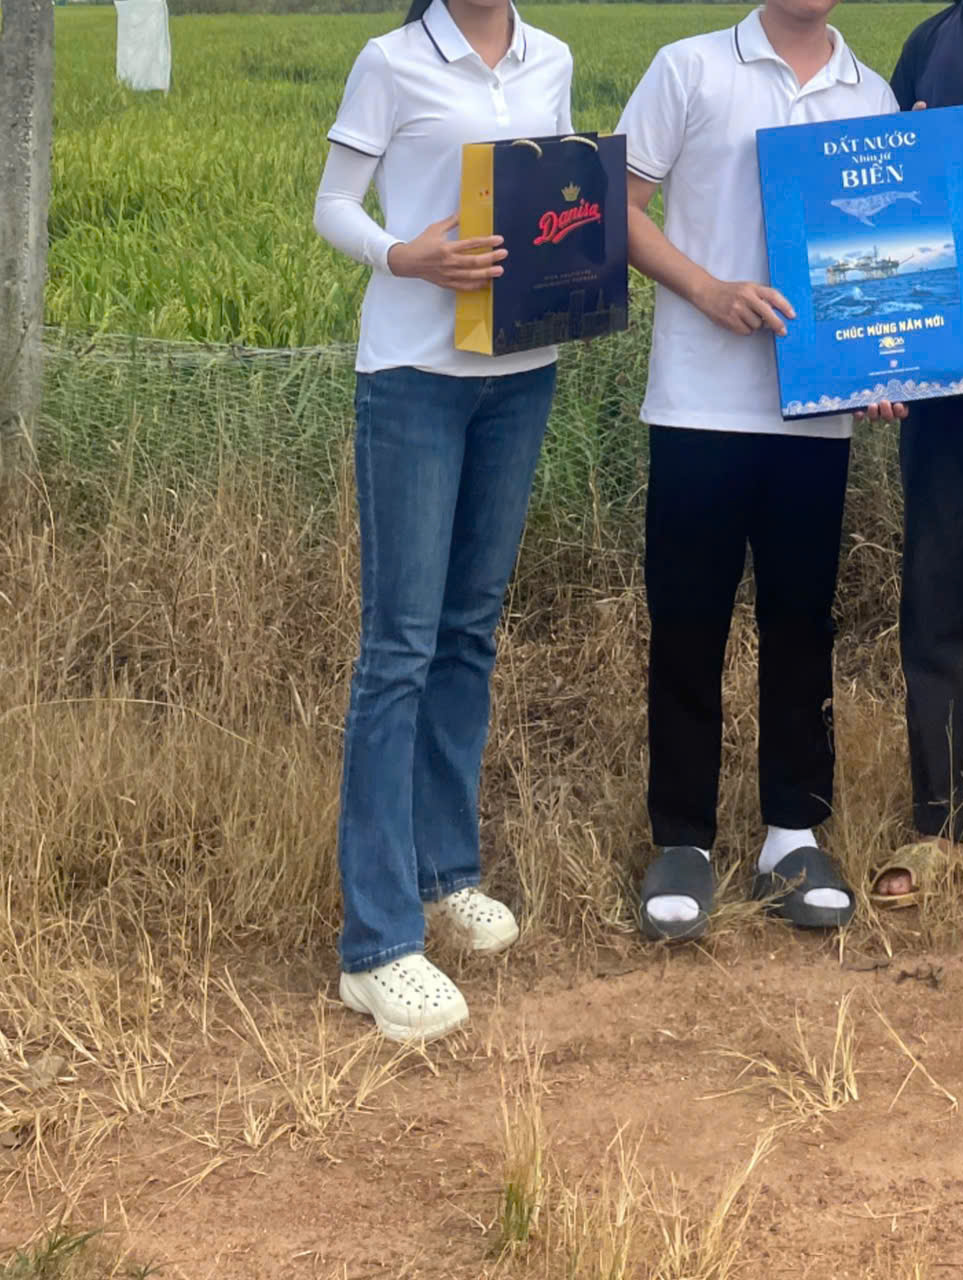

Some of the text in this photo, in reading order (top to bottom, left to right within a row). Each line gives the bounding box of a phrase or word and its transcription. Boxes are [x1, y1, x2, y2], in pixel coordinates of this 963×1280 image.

[533, 198, 602, 245] Danisa
[836, 315, 944, 340] CHÚC MỪNG NĂM MỚI
